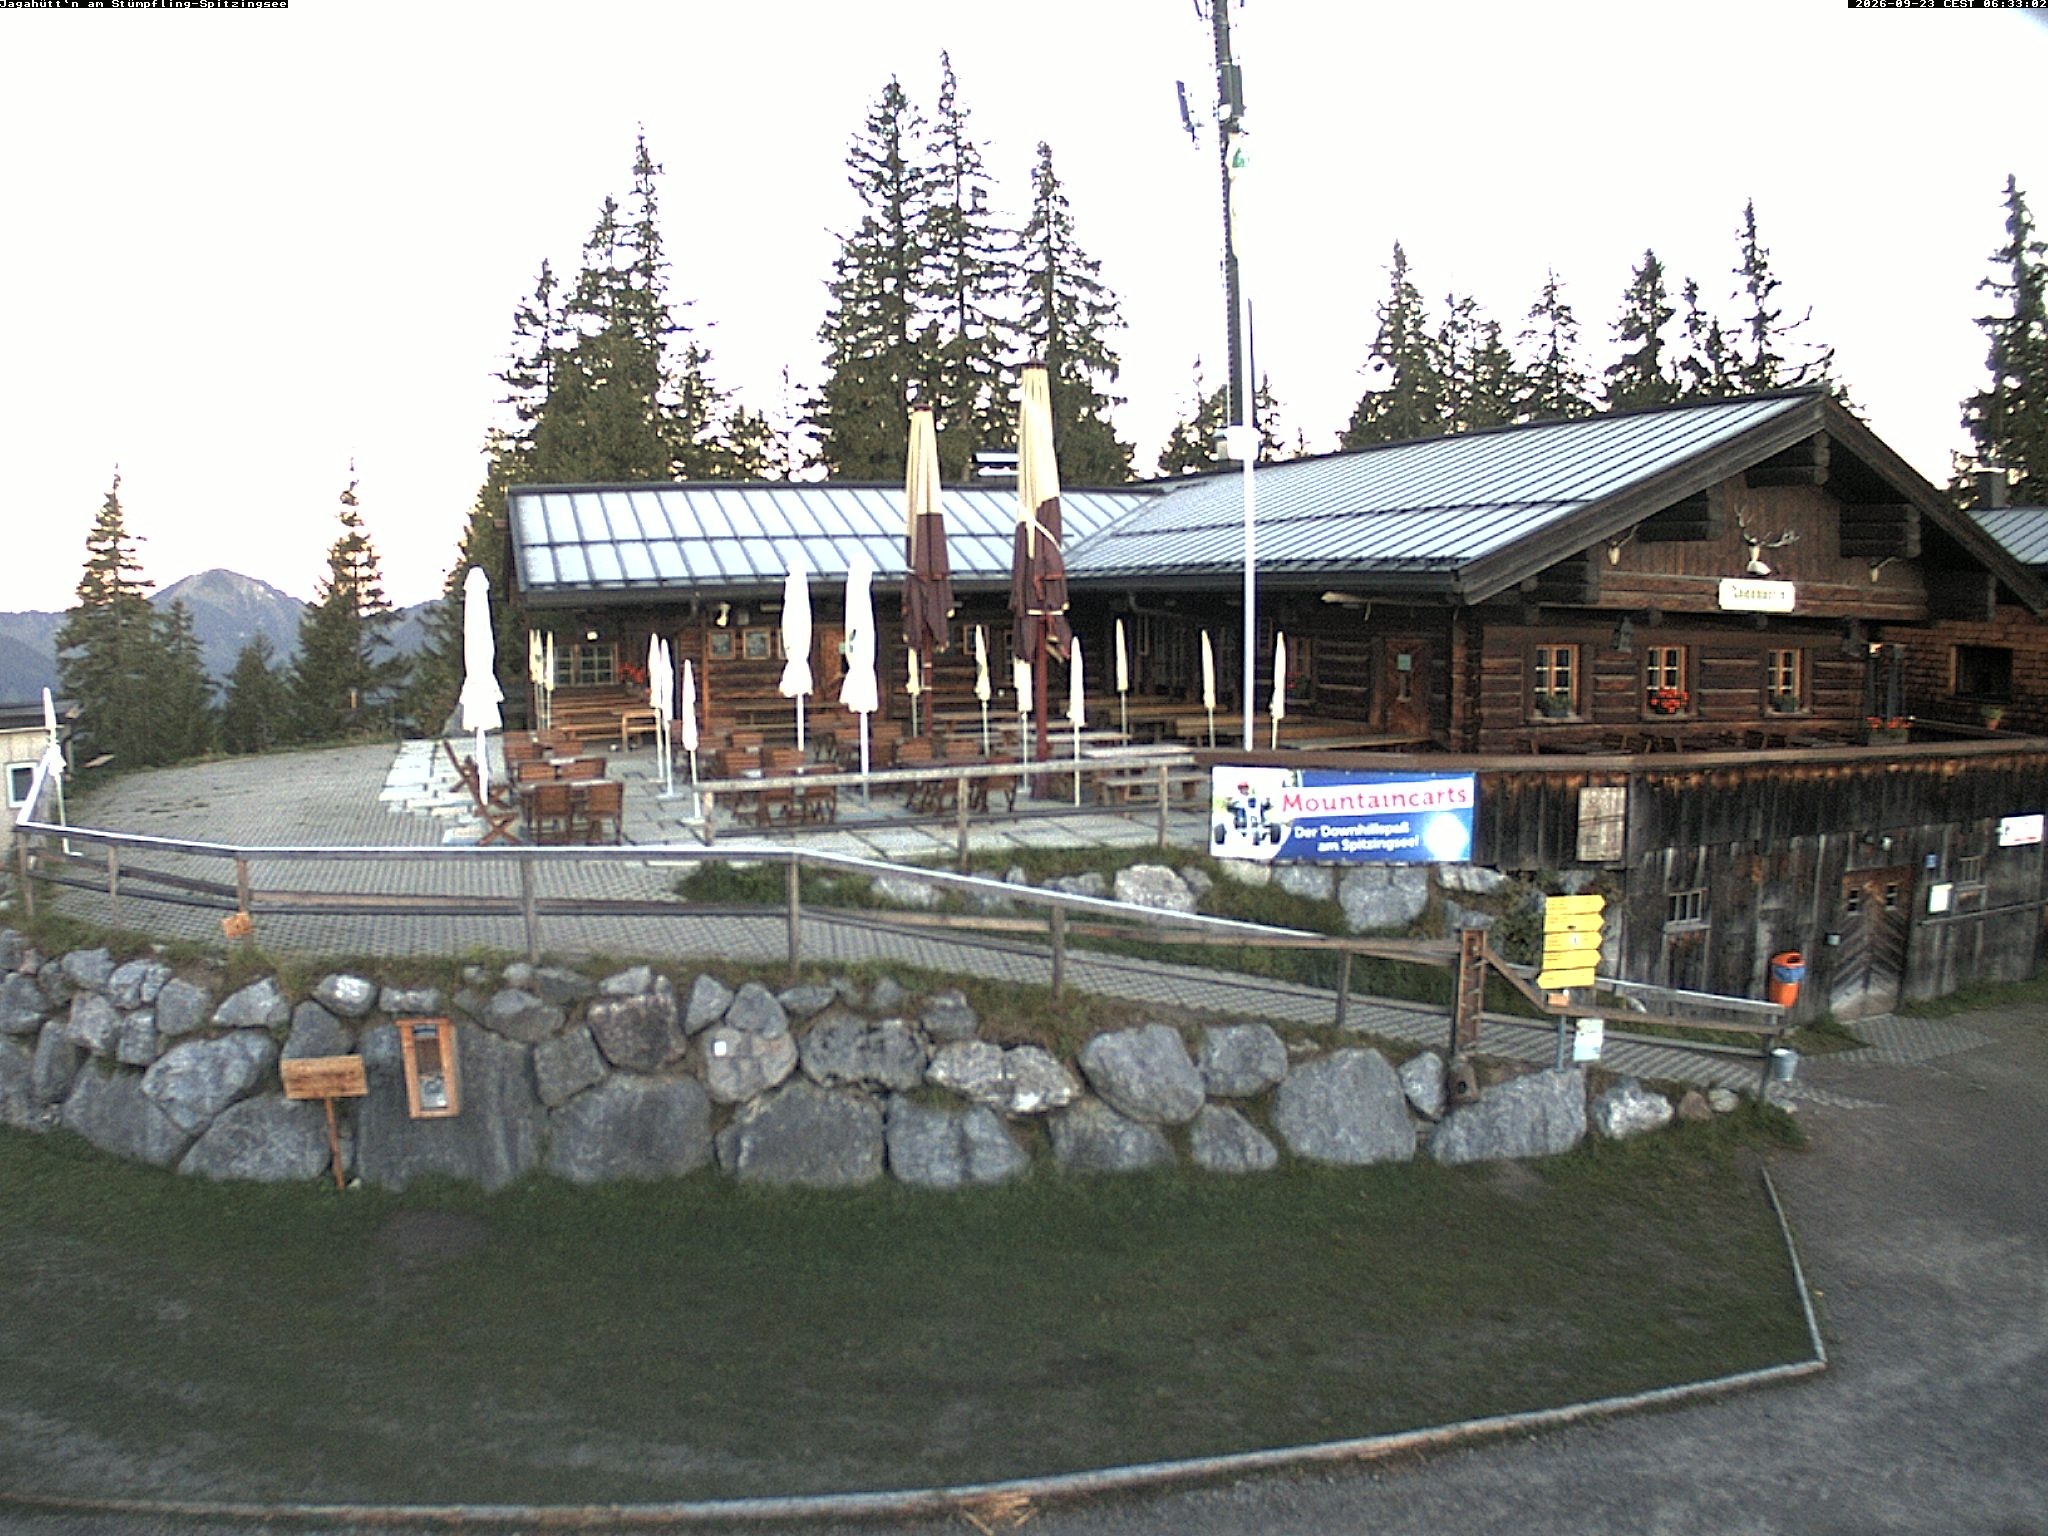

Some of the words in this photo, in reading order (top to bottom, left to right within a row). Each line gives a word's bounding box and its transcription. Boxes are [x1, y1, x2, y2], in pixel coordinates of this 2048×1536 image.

[1282, 787, 1467, 812] Mountaincarts
[1294, 826, 1318, 839] Der
[1317, 841, 1340, 852] am
